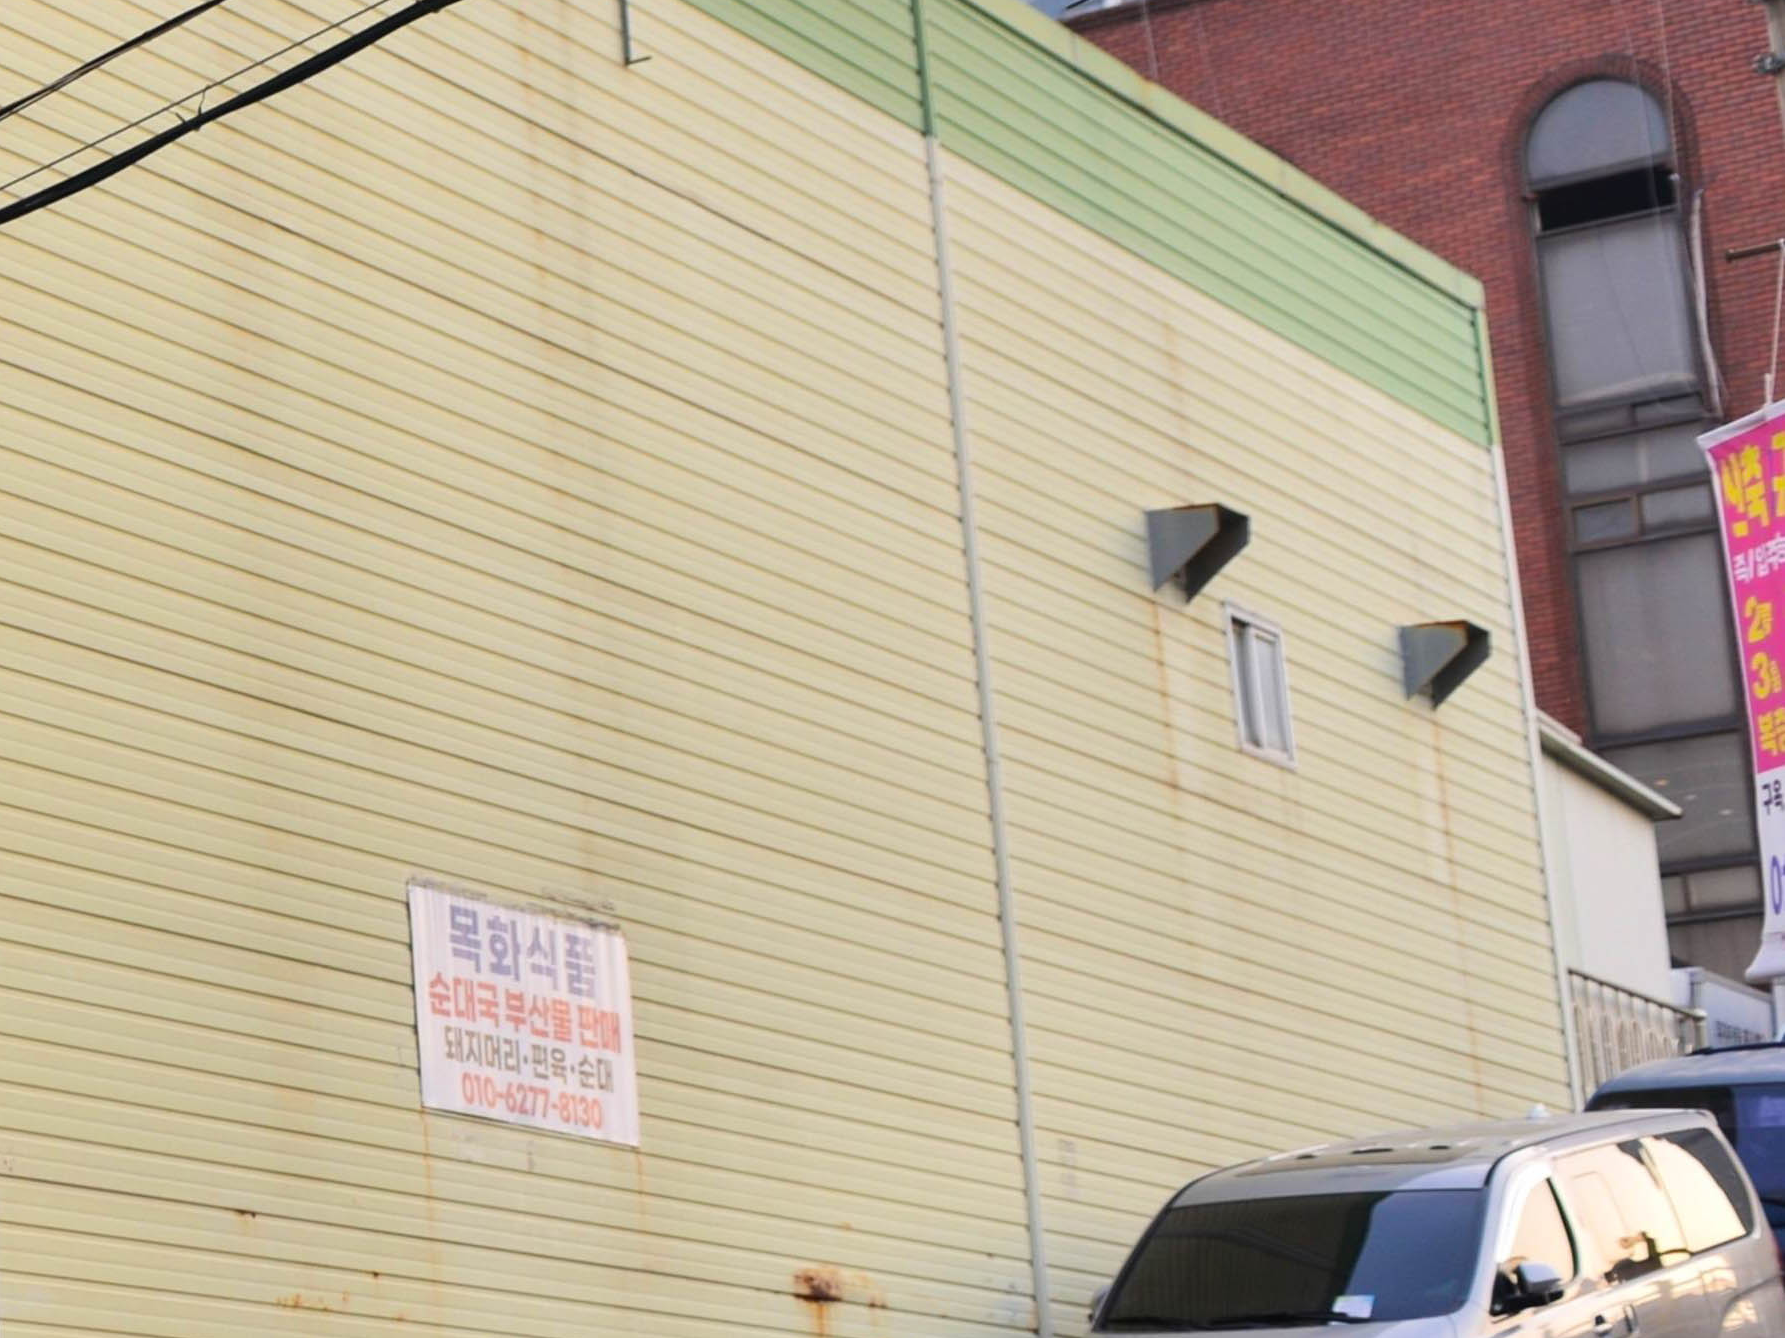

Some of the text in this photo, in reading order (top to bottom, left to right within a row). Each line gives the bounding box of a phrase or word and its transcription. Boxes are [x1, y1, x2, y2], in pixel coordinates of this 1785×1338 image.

[449, 904, 596, 999] 목화식품
[429, 971, 622, 1054] 순대국 부산물 판매
[461, 1071, 604, 1130] 010-6277-8130
